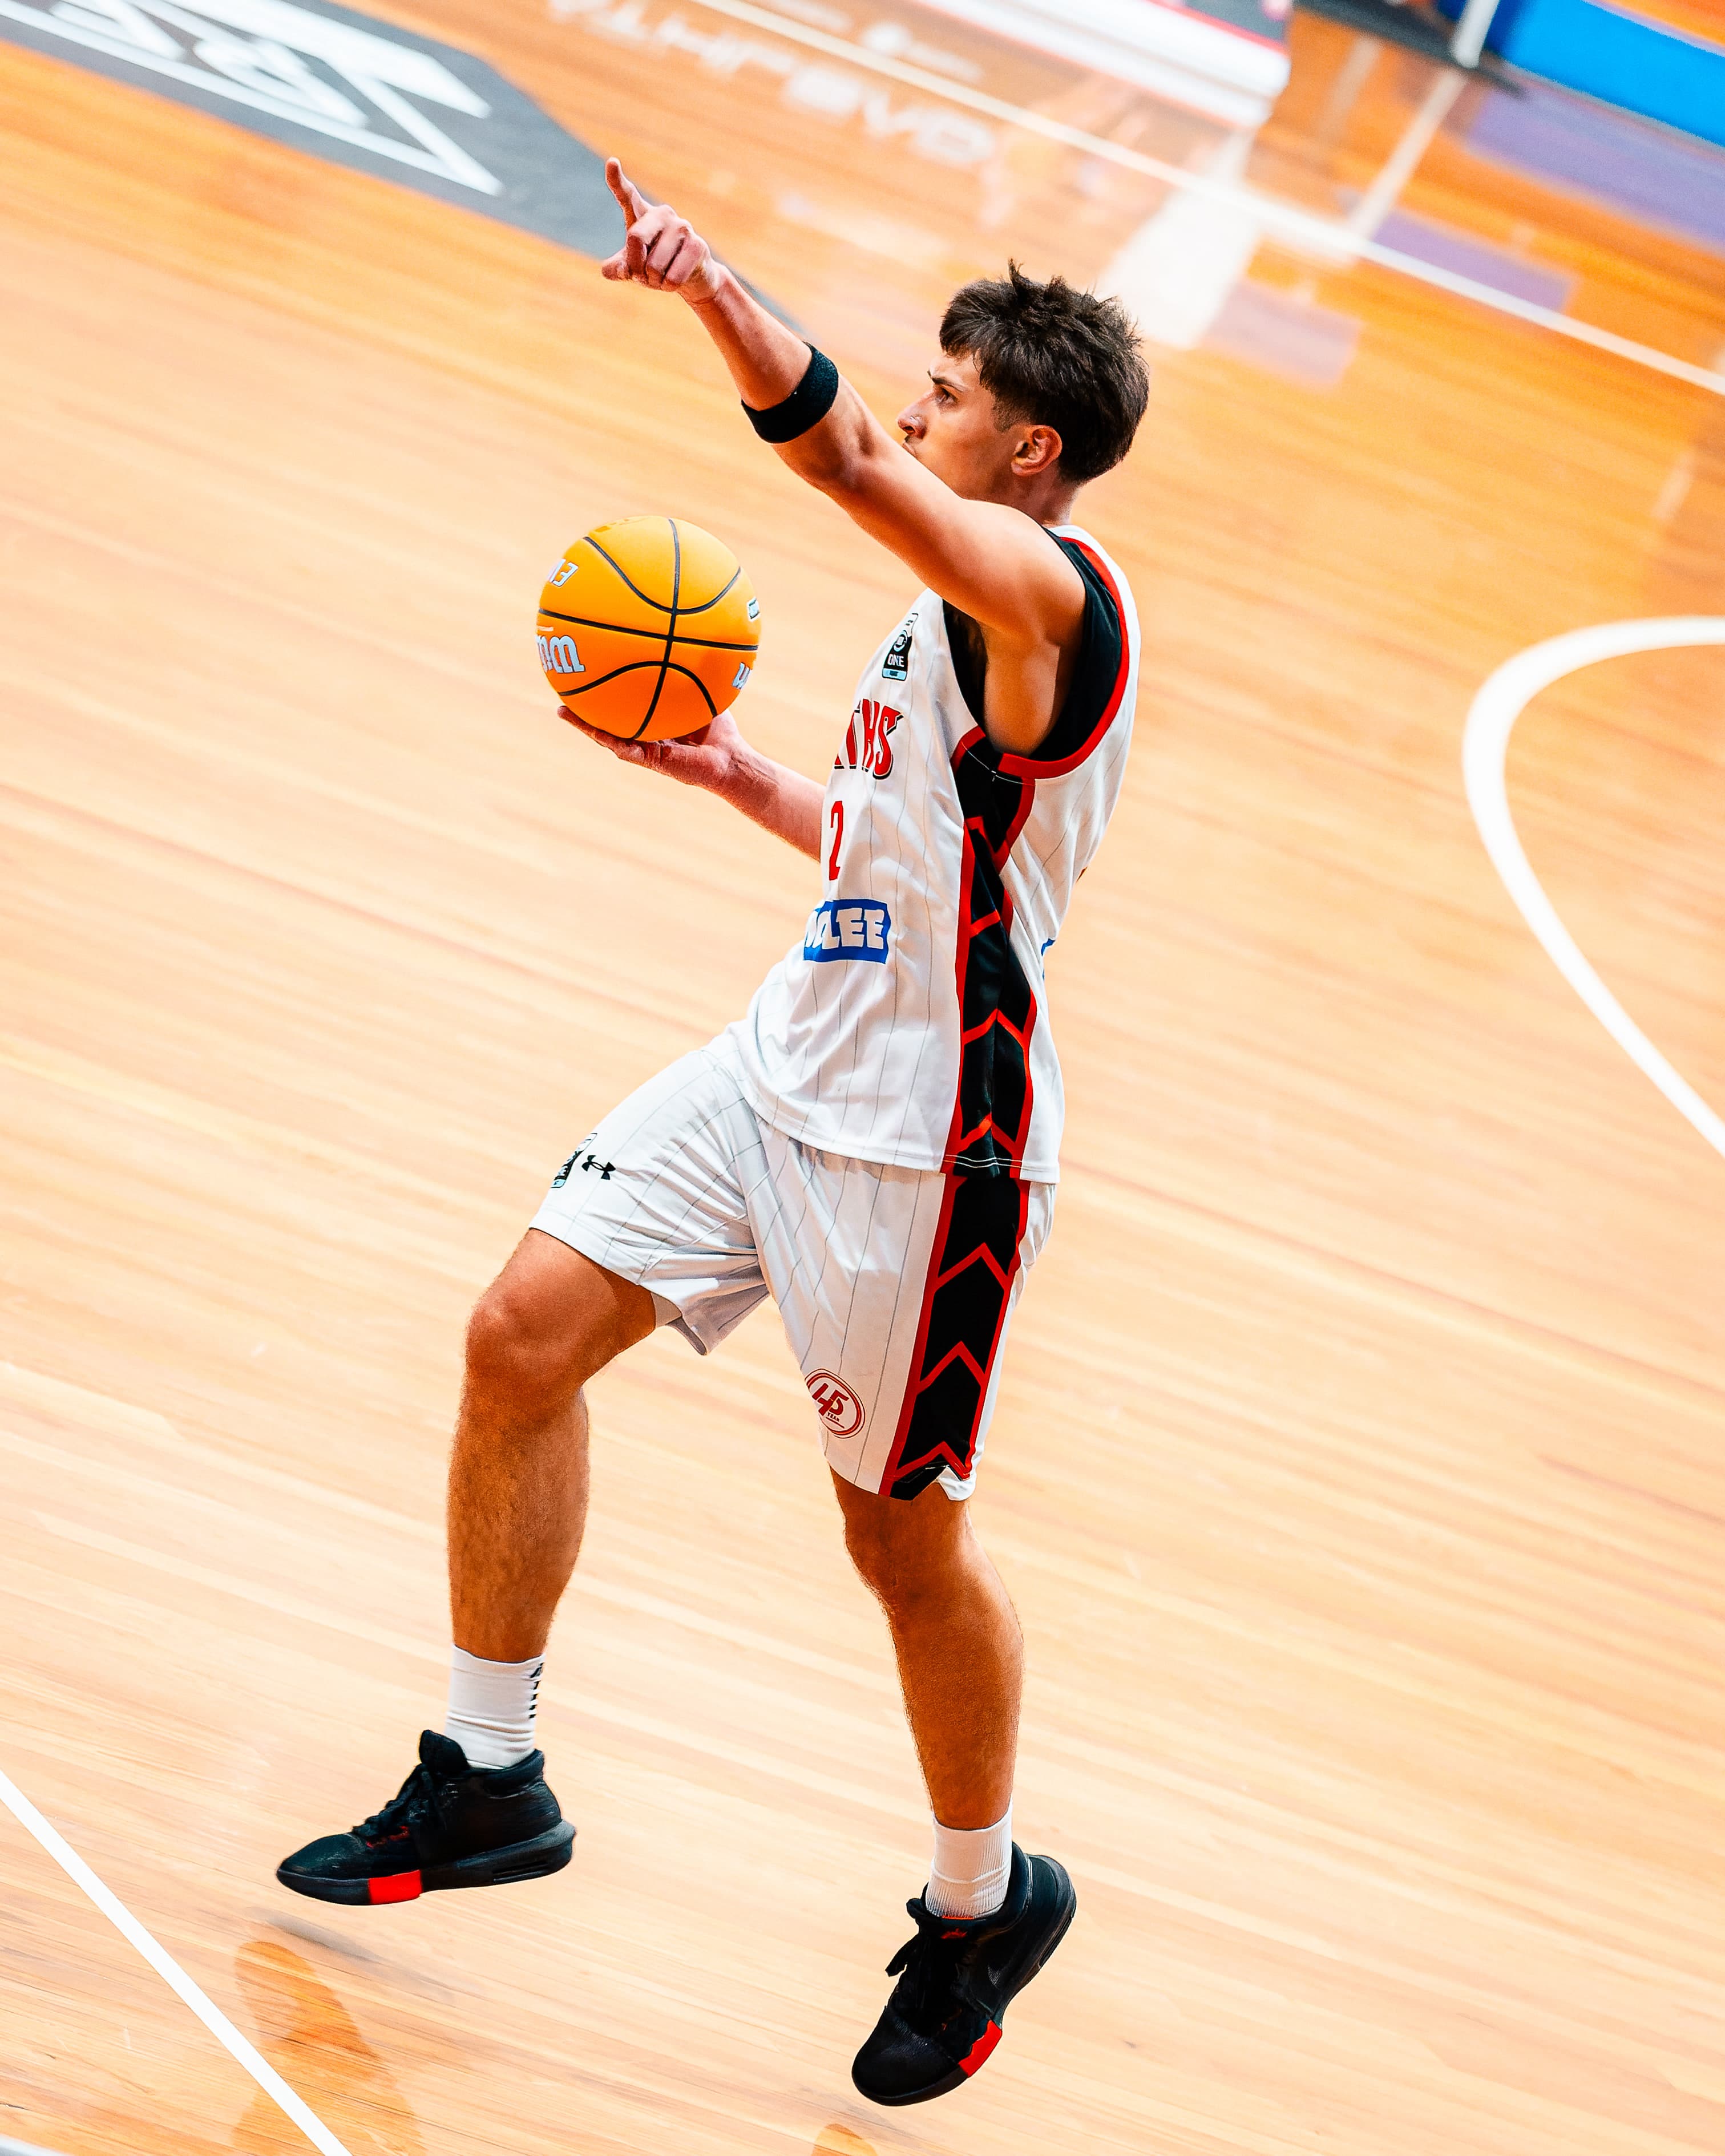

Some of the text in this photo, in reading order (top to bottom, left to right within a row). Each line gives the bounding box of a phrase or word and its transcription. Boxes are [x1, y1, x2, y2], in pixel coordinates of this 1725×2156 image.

[887, 653, 904, 668] ONE
[829, 800, 843, 881] 2
[812, 1383, 850, 1416] 45
